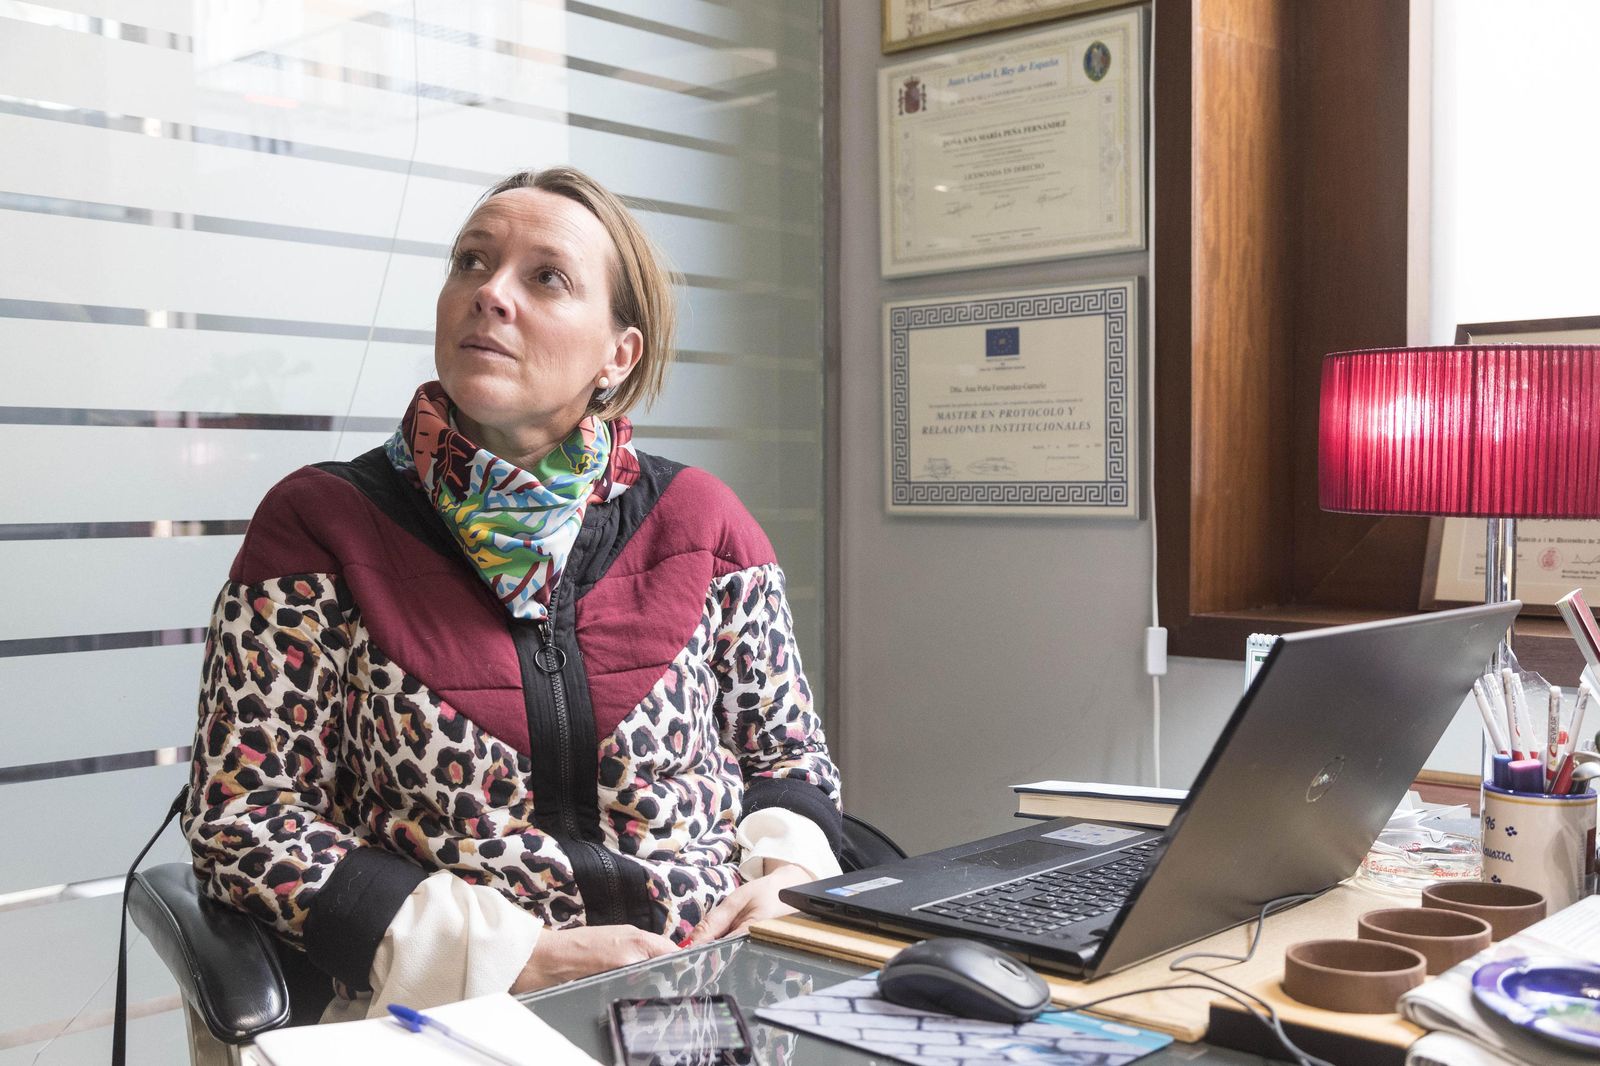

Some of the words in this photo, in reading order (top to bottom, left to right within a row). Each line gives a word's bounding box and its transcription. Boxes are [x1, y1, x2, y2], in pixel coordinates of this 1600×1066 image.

[967, 70, 991, 83] Carlos
[1000, 65, 1015, 77] Rey
[1017, 62, 1027, 73] de
[1028, 58, 1059, 71] España
[963, 134, 978, 144] ANA
[978, 130, 1002, 142] MARÍA
[1002, 126, 1022, 138] PEÑA
[1003, 164, 1013, 175] EN
[1013, 160, 1046, 174] DERECHO
[936, 409, 978, 421] MASTER
[980, 408, 995, 419] EN
[998, 406, 1065, 419] PROTOCOLO
[1067, 405, 1077, 416] Y
[921, 423, 987, 436] RELACIONES
[989, 420, 1092, 434] INSTITUCIONALES
